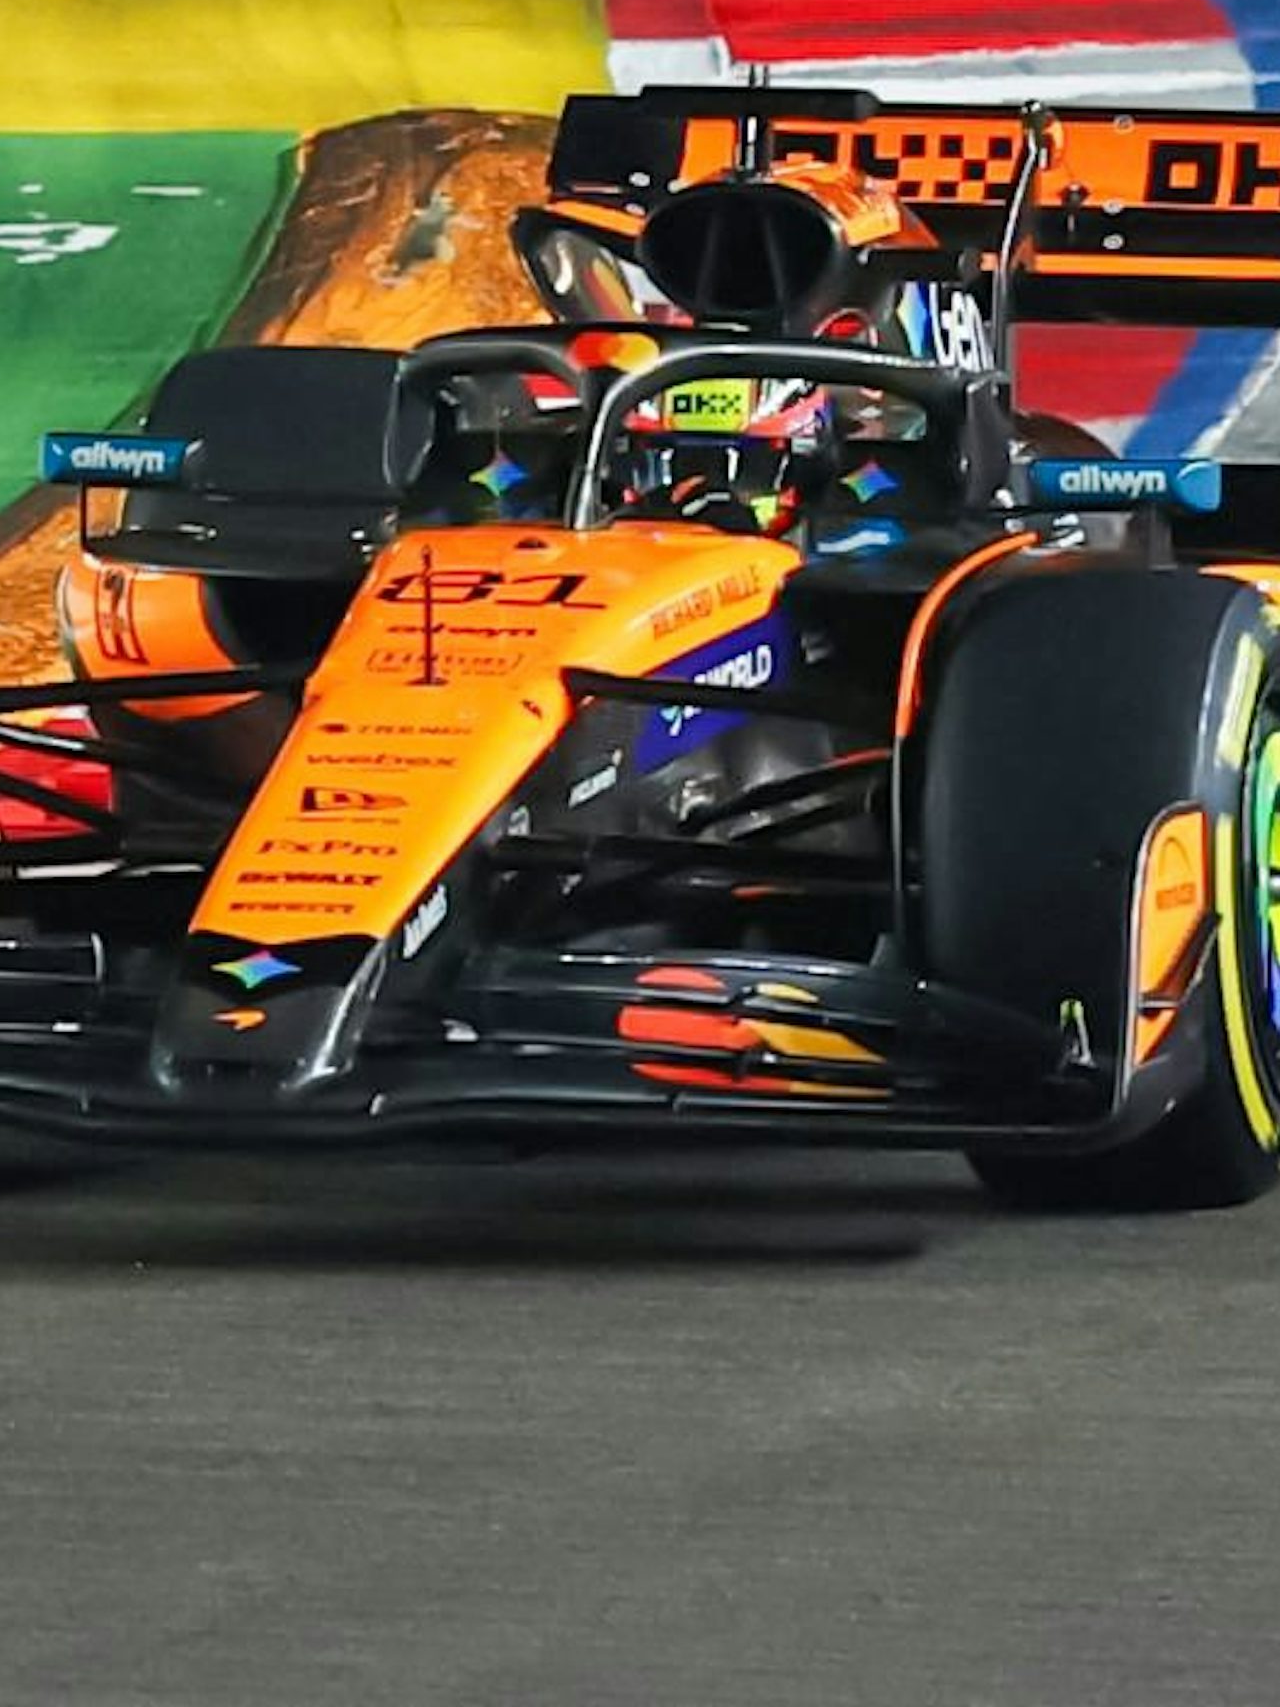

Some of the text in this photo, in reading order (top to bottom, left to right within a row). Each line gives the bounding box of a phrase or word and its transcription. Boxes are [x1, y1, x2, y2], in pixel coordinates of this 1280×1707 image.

[70, 441, 166, 478] allwyn
[1059, 464, 1167, 499] allwyn
[376, 570, 607, 610] 81
